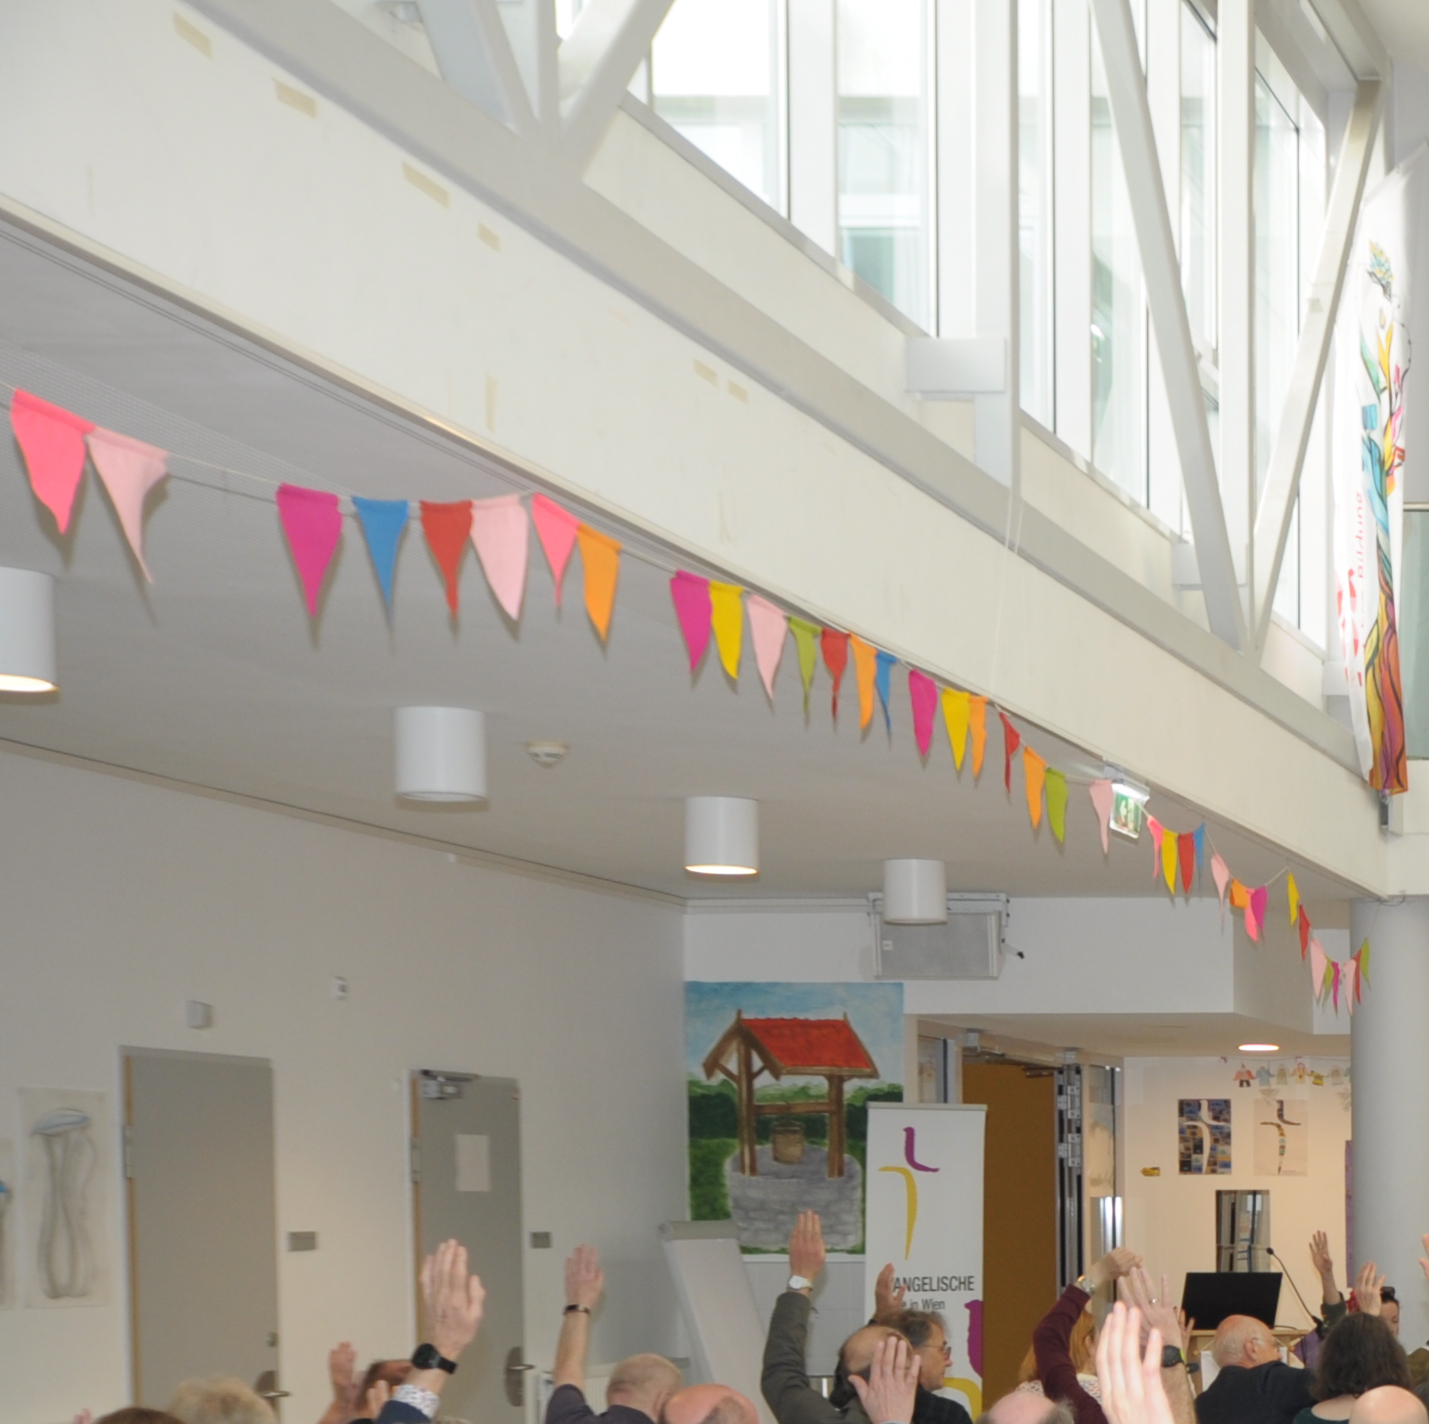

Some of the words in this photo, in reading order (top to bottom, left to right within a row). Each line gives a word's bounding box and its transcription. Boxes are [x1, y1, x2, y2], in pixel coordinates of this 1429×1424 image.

[892, 1275, 975, 1292] ANGELISCHE
[910, 1299, 919, 1309] in
[921, 1299, 946, 1310] Wien
